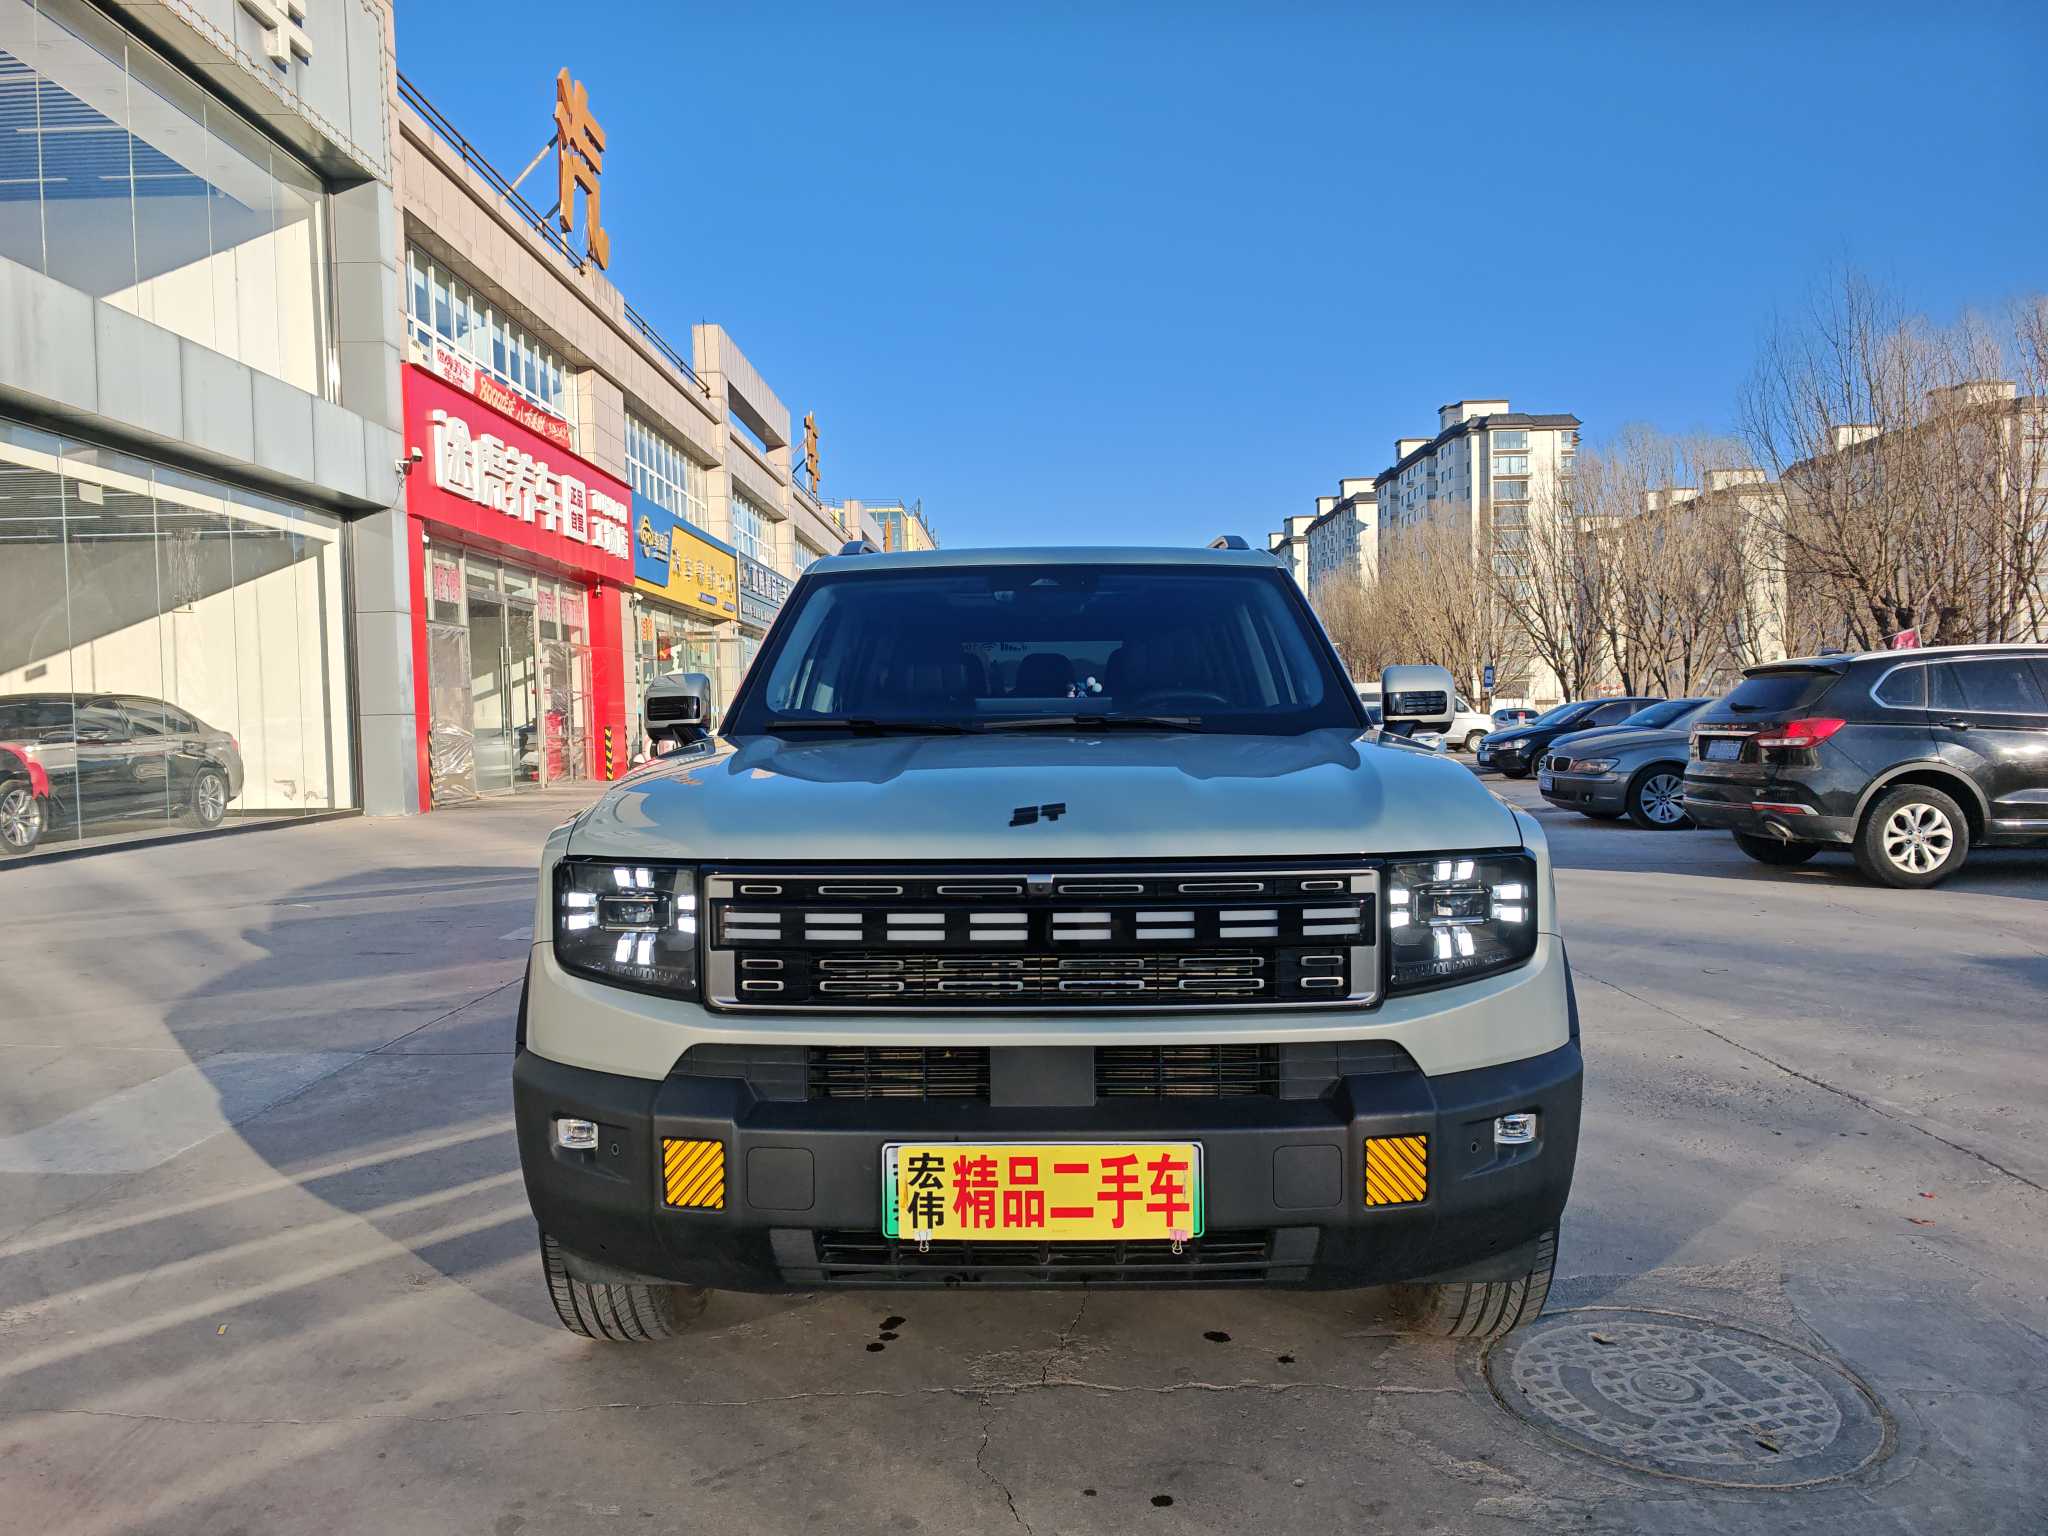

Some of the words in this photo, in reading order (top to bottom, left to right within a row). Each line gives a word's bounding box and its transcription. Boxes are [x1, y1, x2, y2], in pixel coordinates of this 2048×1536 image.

[432, 408, 563, 531] 途虎养车
[907, 1152, 945, 1229] 宏伟
[952, 1152, 1190, 1229] 精品二手车
